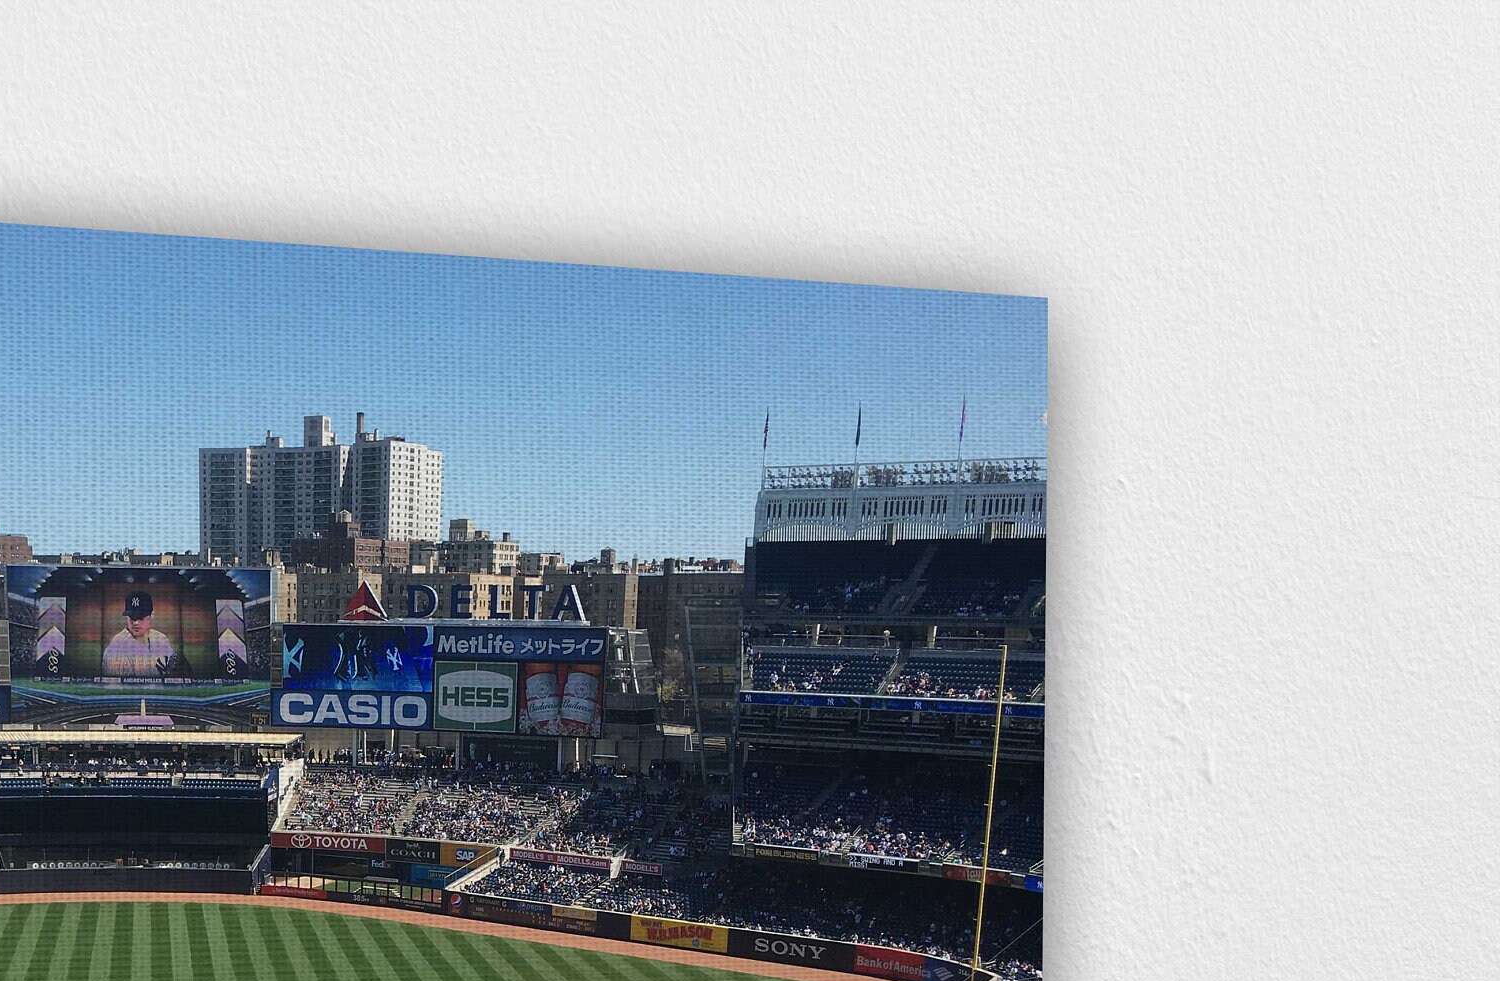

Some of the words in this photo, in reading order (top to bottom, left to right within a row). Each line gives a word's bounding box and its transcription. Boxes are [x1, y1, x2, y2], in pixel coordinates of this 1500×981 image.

[408, 583, 587, 623] DELTA
[437, 632, 515, 655] MetLife
[520, 637, 604, 656] メットライフ
[442, 686, 510, 708] HESS
[279, 692, 429, 727] CASIO
[314, 837, 368, 850] TOYOTA
[390, 848, 436, 859] COACH
[456, 850, 475, 861] SAP
[513, 850, 545, 861] MODELL'S
[557, 854, 607, 868] MODELLS.com
[773, 850, 818, 861] BUSINESS
[625, 862, 659, 873] MODELL'S
[754, 938, 827, 960] SONY
[856, 956, 884, 968] Bank
[884, 960, 895, 972] of
[894, 961, 931, 979] America
